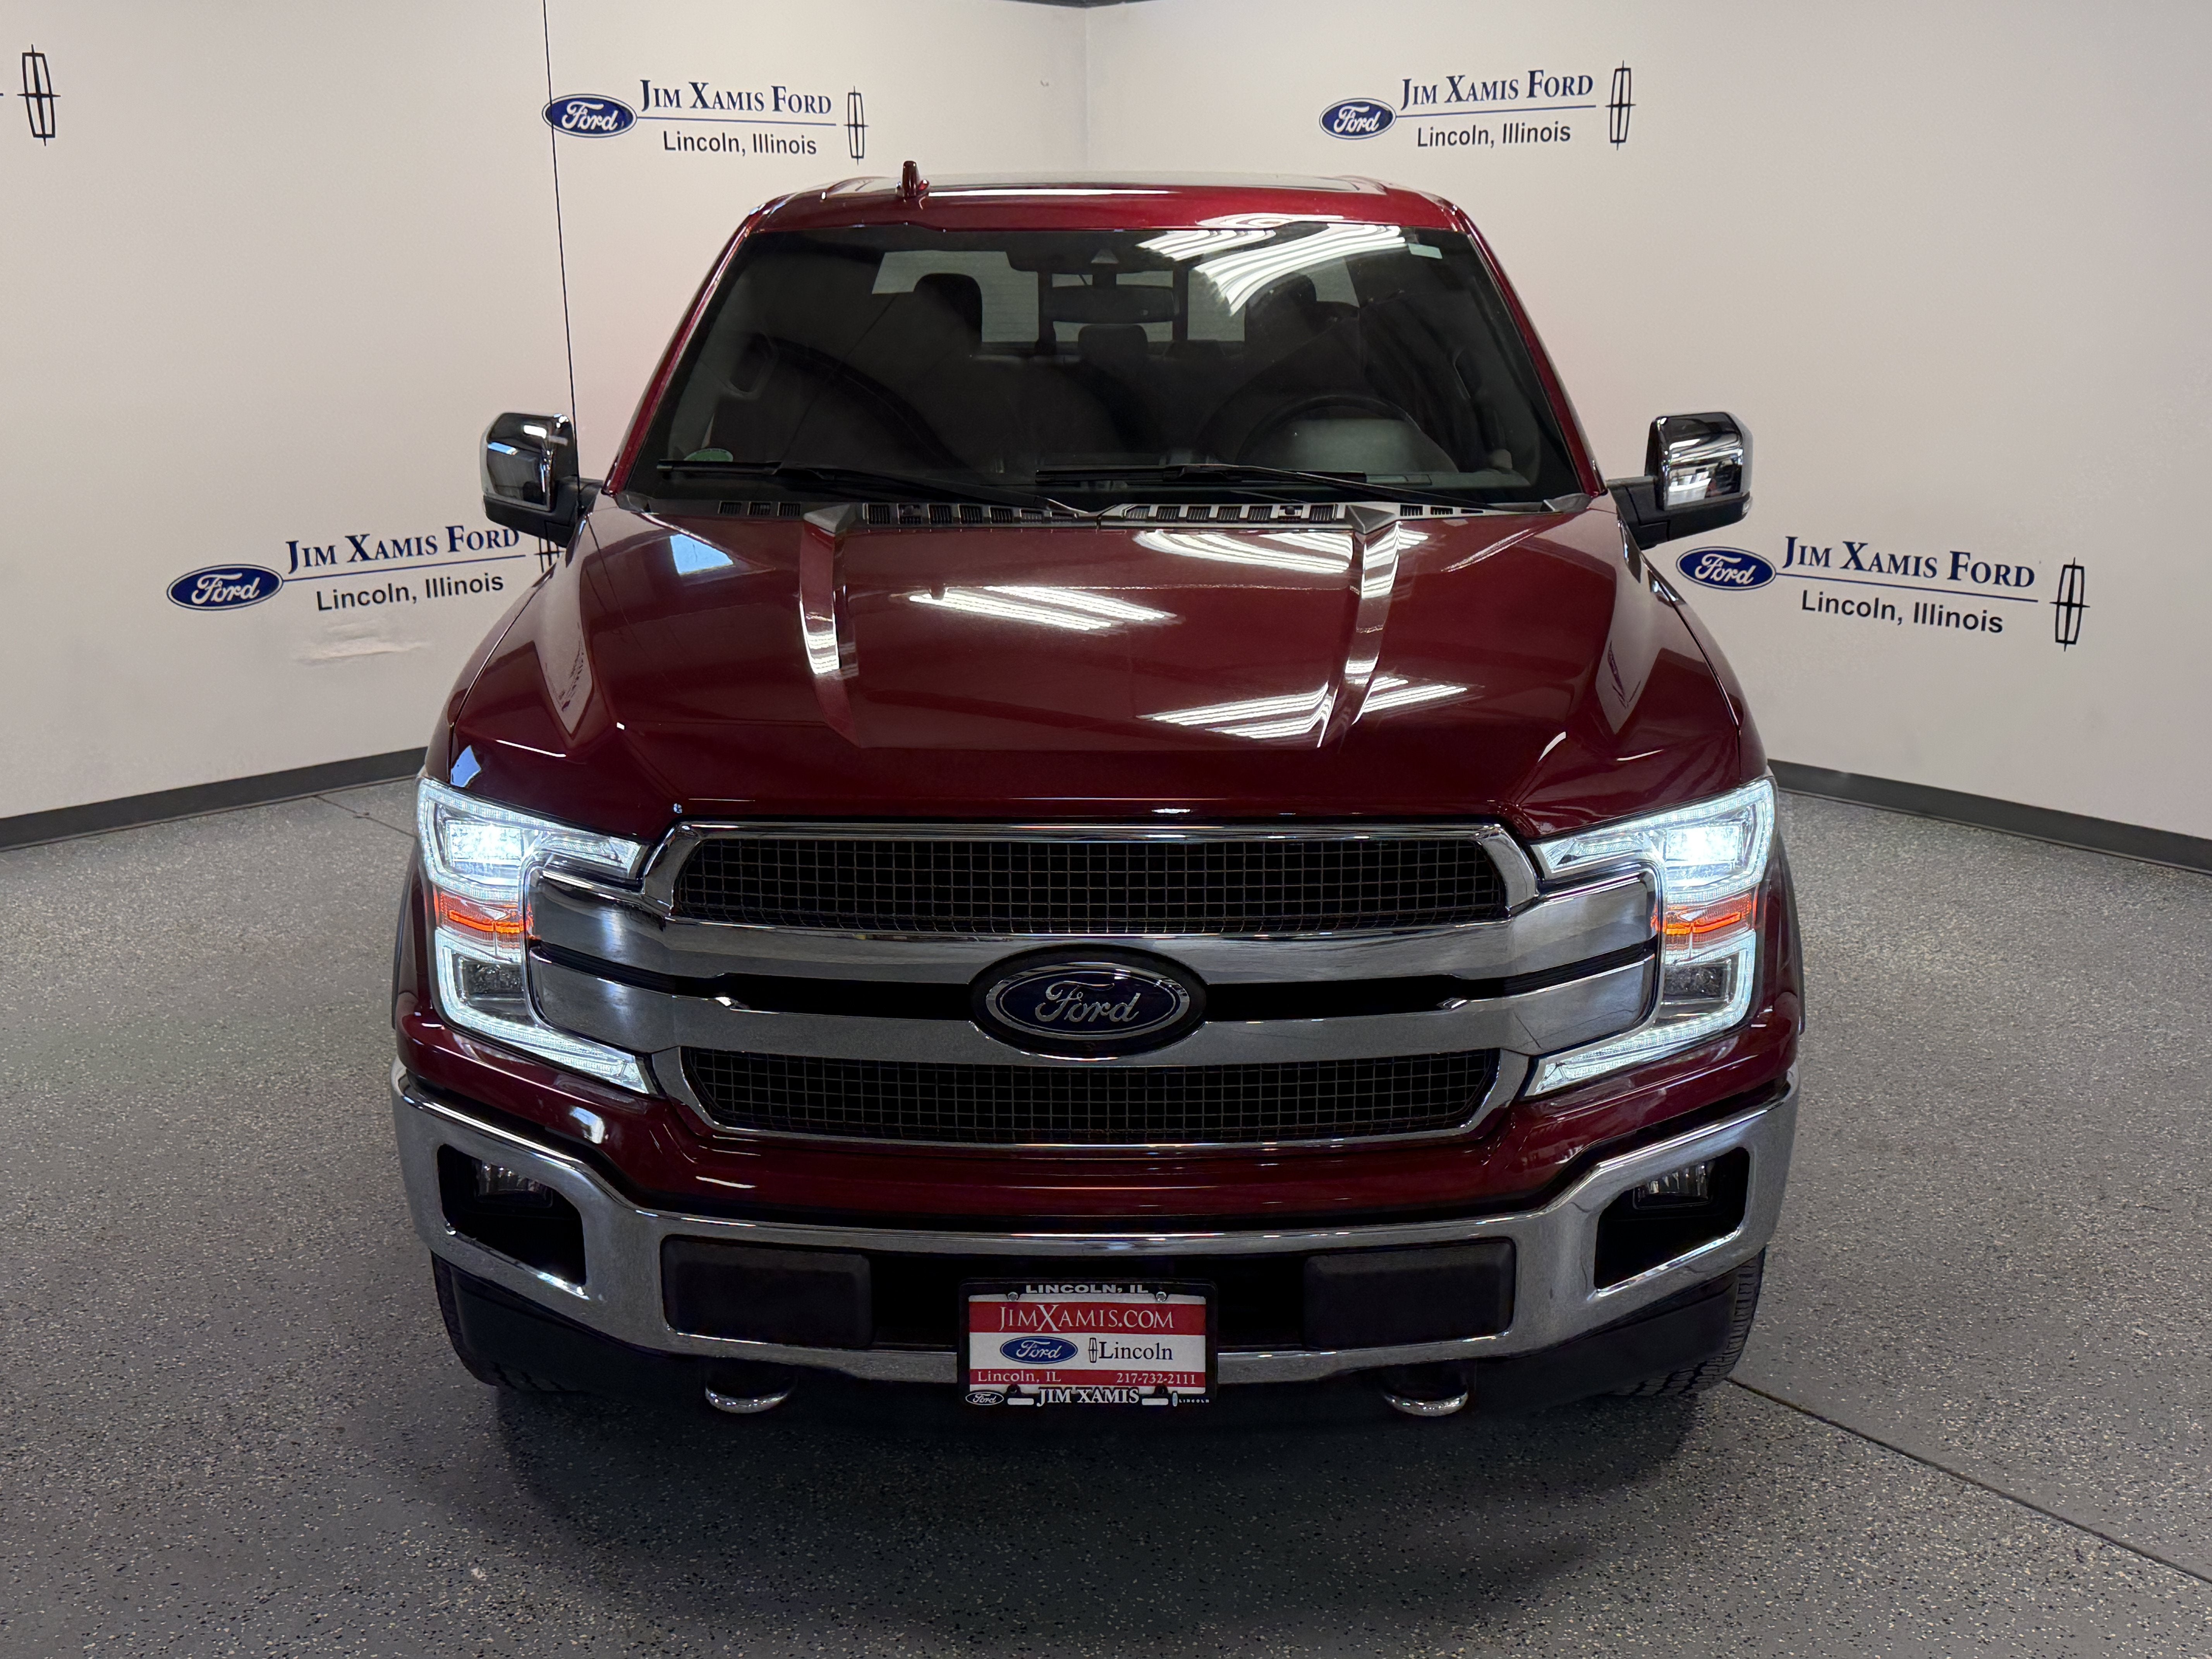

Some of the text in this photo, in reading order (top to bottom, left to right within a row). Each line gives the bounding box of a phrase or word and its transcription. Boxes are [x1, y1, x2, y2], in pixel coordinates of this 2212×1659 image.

[640, 79, 832, 115] JIM XAMIS FORD
[1401, 70, 1594, 111] JIM XAMIS FORD
[562, 101, 618, 131] Ford
[1333, 106, 1379, 133] Ford
[663, 131, 817, 156] Lincoln, Illinois
[1417, 121, 1571, 148] Lincoln, Illinois
[285, 525, 520, 574] JIM XAMIS FORD
[1782, 536, 2036, 588] JIM XAMIS FORD
[1694, 554, 1754, 585] Ford
[191, 574, 260, 605] Ford
[316, 572, 504, 611] Lincoln, Illinois
[1802, 590, 2003, 634] Lincoln, Illinois
[1035, 980, 1141, 1022] Ford
[1026, 1285, 1149, 1294] LINCOLN, IL
[999, 1305, 1174, 1331] JIMXAMIS.COM
[1016, 1340, 1061, 1359] Ford
[1099, 1341, 1173, 1360] Lincoln
[978, 1371, 1061, 1383] Lincoln, IL
[1116, 1372, 1195, 1384] 217-732-2111
[972, 1394, 996, 1403] Ford
[1037, 1388, 1139, 1407] JIM XAMIS
